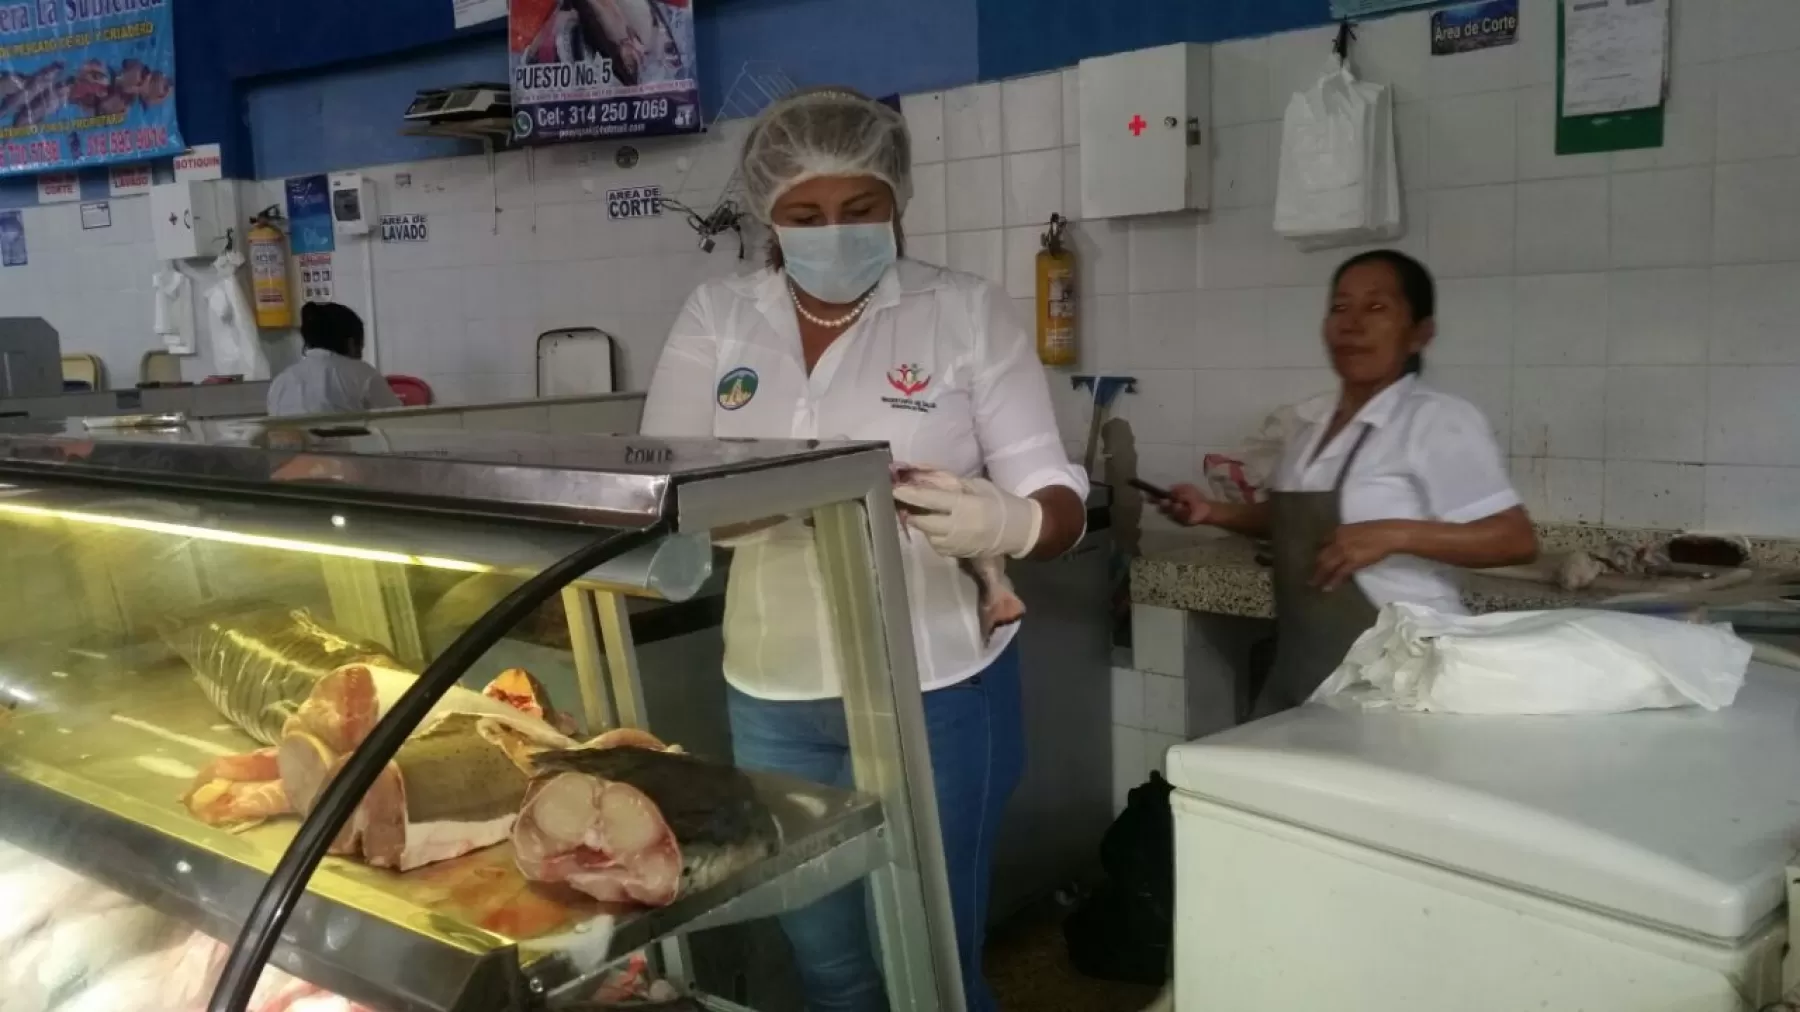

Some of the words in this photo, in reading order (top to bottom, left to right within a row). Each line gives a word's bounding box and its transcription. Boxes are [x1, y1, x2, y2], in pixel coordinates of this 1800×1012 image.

[1464, 21, 1479, 37] de
[1482, 15, 1517, 33] Corte
[516, 65, 571, 90] PUESTO
[575, 63, 597, 86] No.
[602, 61, 611, 84] 5
[538, 107, 565, 126] Cel:
[569, 104, 596, 125] 314
[601, 101, 628, 122] 250
[633, 99, 668, 120] 7069
[643, 187, 660, 198] DE
[609, 198, 661, 217] CORTE
[381, 224, 427, 241] LAVADO
